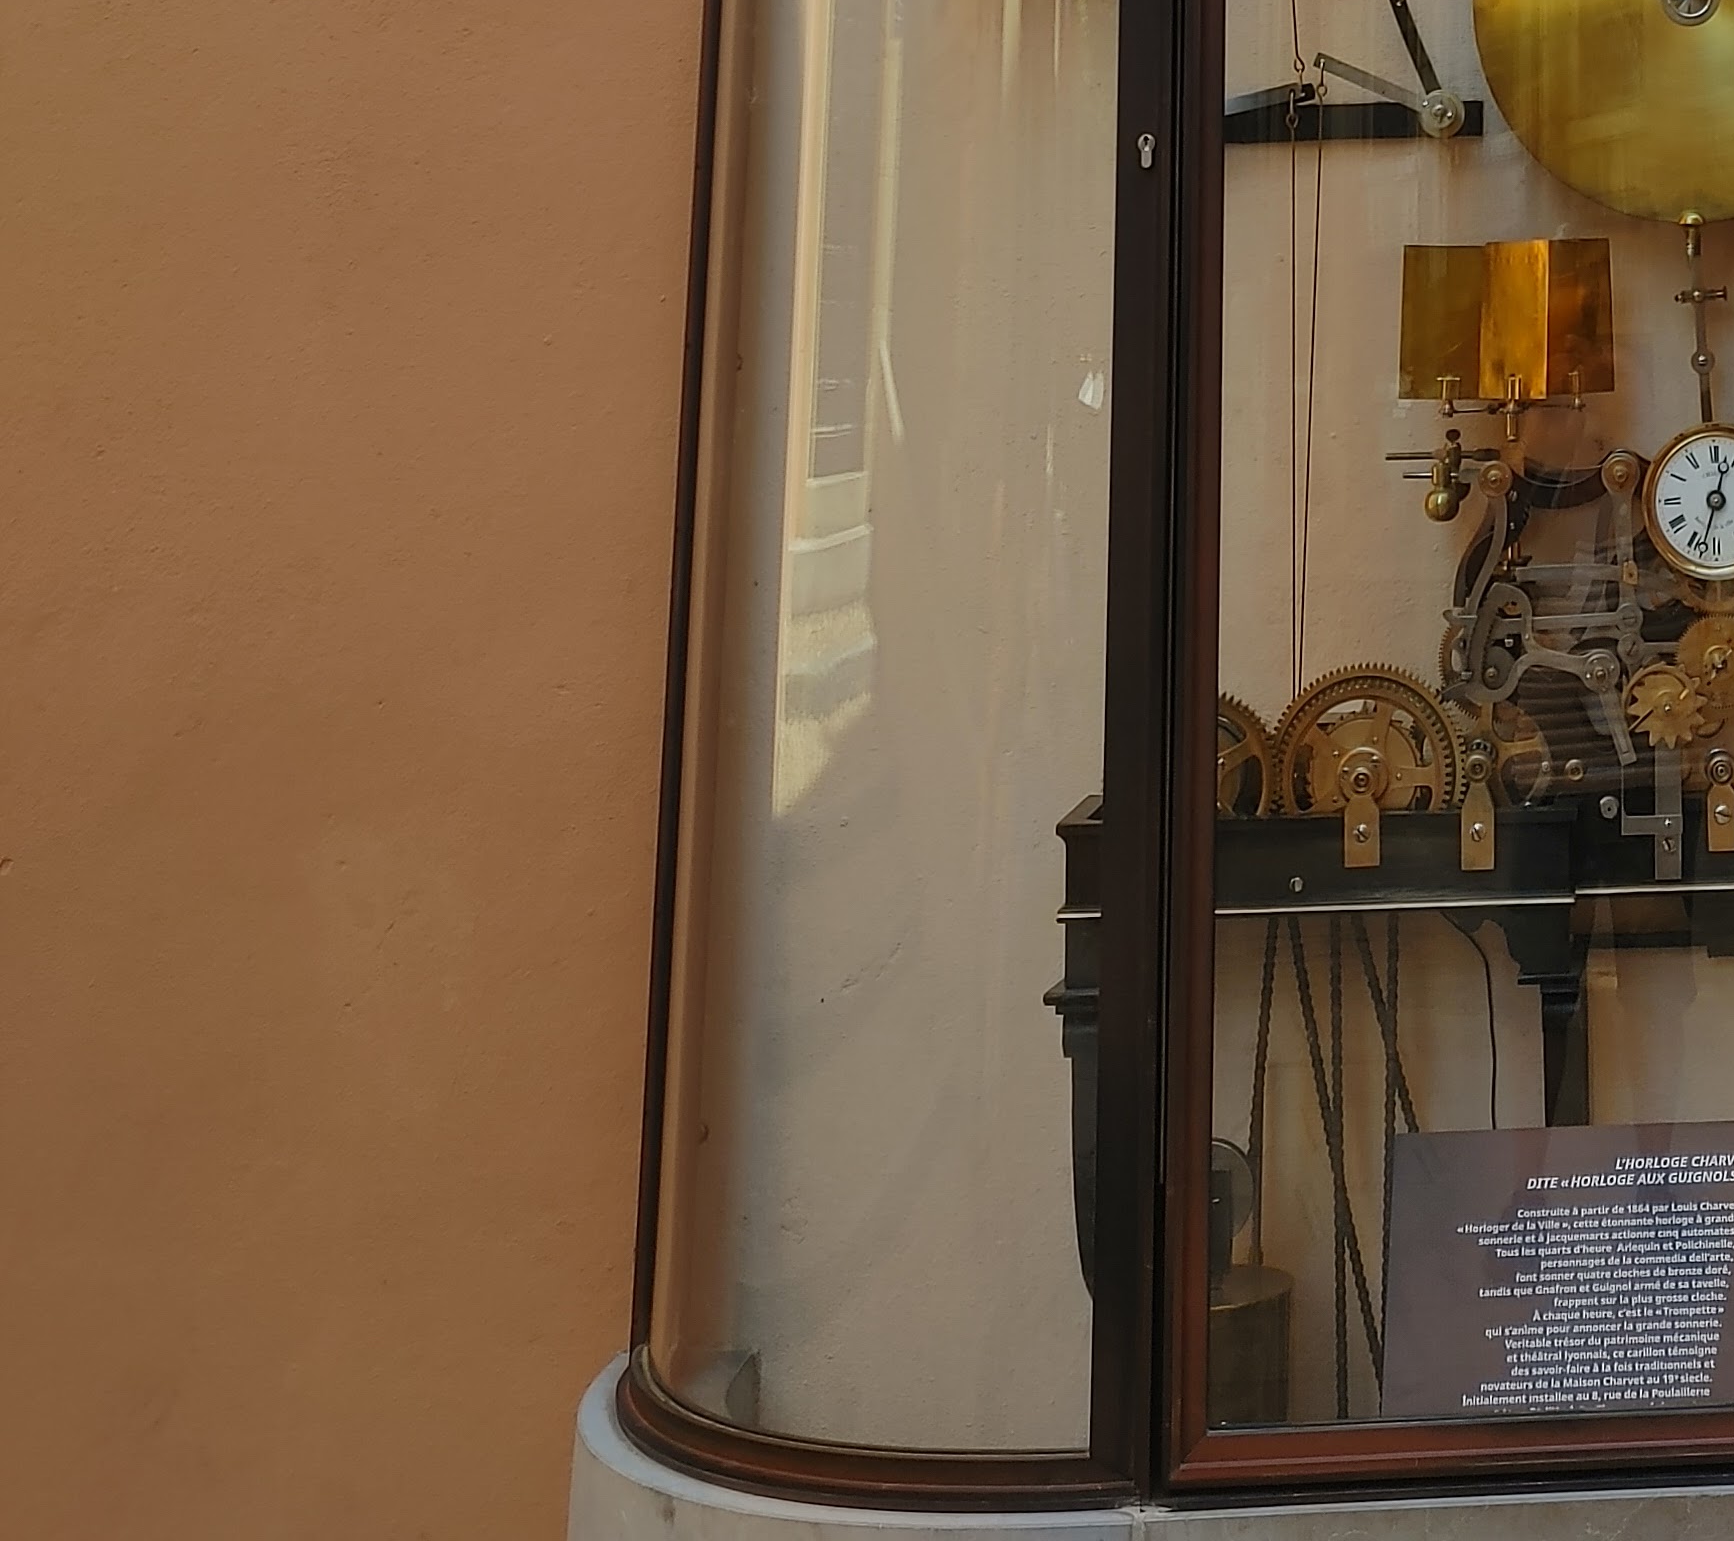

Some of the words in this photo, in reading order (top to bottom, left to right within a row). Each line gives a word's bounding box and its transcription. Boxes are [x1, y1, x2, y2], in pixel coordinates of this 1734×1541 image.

[1615, 1156, 1688, 1170] L'HORLOGE
[1527, 1177, 1559, 1189] DITE
[1636, 1173, 1666, 1185] AUX
[1518, 1206, 1570, 1218] Construite
[1581, 1205, 1609, 1217] partir
[1612, 1204, 1624, 1214] de
[1652, 1204, 1668, 1215] par
[1672, 1201, 1697, 1211] Louis
[1512, 1222, 1524, 1231] de
[1527, 1221, 1535, 1231] la
[1538, 1222, 1559, 1233] Ville
[1574, 1219, 1598, 1229] cette
[1602, 1218, 1654, 1228] étonnante
[1656, 1215, 1693, 1228] horloge
[1479, 1234, 1522, 1245] sonnerie
[1525, 1234, 1535, 1243] et
[1612, 1229, 1655, 1240] actionne
[1496, 1247, 1519, 1257] Tous
[1522, 1246, 1535, 1256] les
[1538, 1245, 1571, 1258] quarts
[1617, 1241, 1660, 1255] Arlequin
[1663, 1241, 1673, 1251] et
[1541, 1258, 1605, 1271] personnages
[1608, 1256, 1620, 1266] de
[1623, 1256, 1631, 1265] la
[1634, 1253, 1686, 1265] commedia
[1516, 1272, 1536, 1282] font
[1540, 1272, 1574, 1281] sonner
[1577, 1269, 1610, 1282] quatre
[1614, 1268, 1650, 1278] cloches
[1653, 1267, 1665, 1277] de
[1668, 1266, 1702, 1276] bronze
